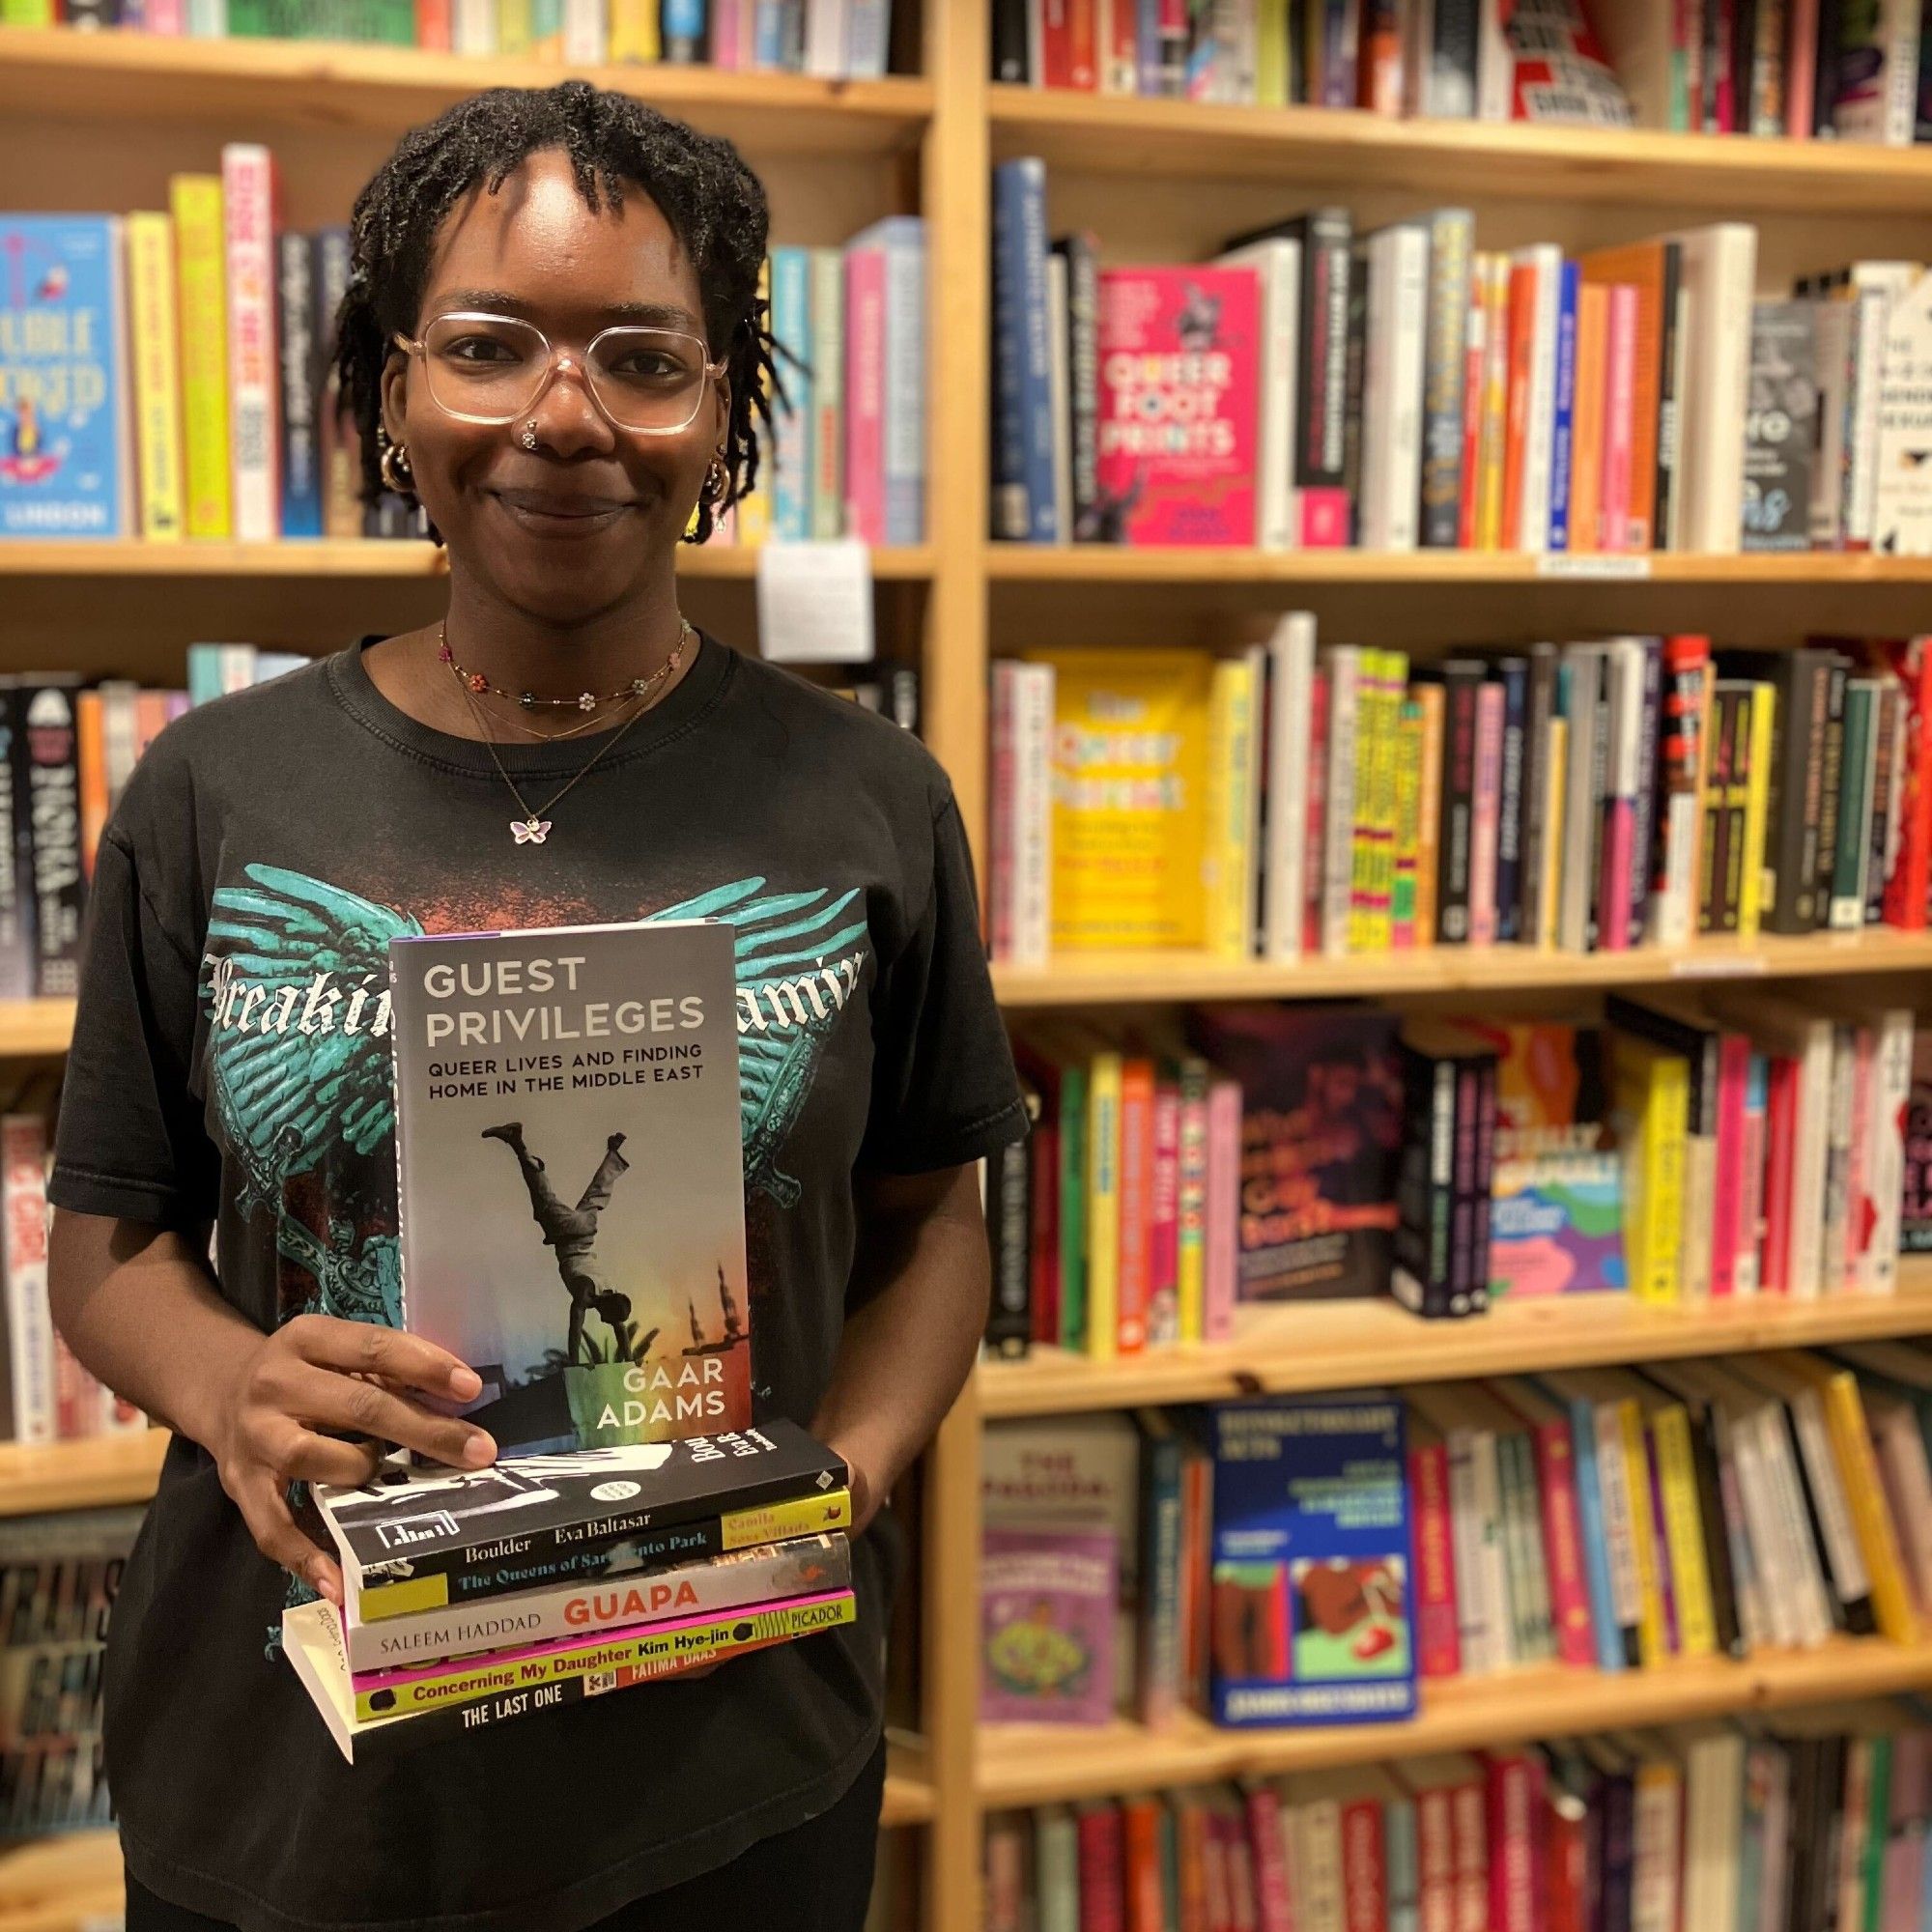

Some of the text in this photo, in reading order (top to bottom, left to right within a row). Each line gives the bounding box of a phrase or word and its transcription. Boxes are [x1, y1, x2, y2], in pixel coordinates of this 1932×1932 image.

[204, 952, 865, 1037] Breakin amin
[423, 956, 586, 999] GUEST
[426, 996, 705, 1047] PRIVILEGES
[428, 1044, 702, 1078] QUEER LIVES AND FINDING
[429, 1065, 704, 1099] HOME IN THE MIDDLE EAST
[623, 1358, 724, 1393] GAAR
[596, 1390, 725, 1430] ADAMS
[458, 1573, 492, 1591] The
[496, 1562, 555, 1585] Queens
[558, 1553, 579, 1574] of
[669, 1532, 707, 1550] Park
[465, 1513, 651, 1564] Boulder Eva Baltasar
[380, 1629, 450, 1655] SALEEM
[458, 1612, 541, 1642] HADDAD
[563, 1580, 699, 1626] GUAPA
[413, 1604, 843, 1701] Concerning My Daughter Kim Hye-jin PICADOR
[462, 1706, 490, 1729] THE
[496, 1692, 529, 1719] LAST
[534, 1684, 563, 1709] ONE
[632, 1656, 678, 1682] FATIMA
